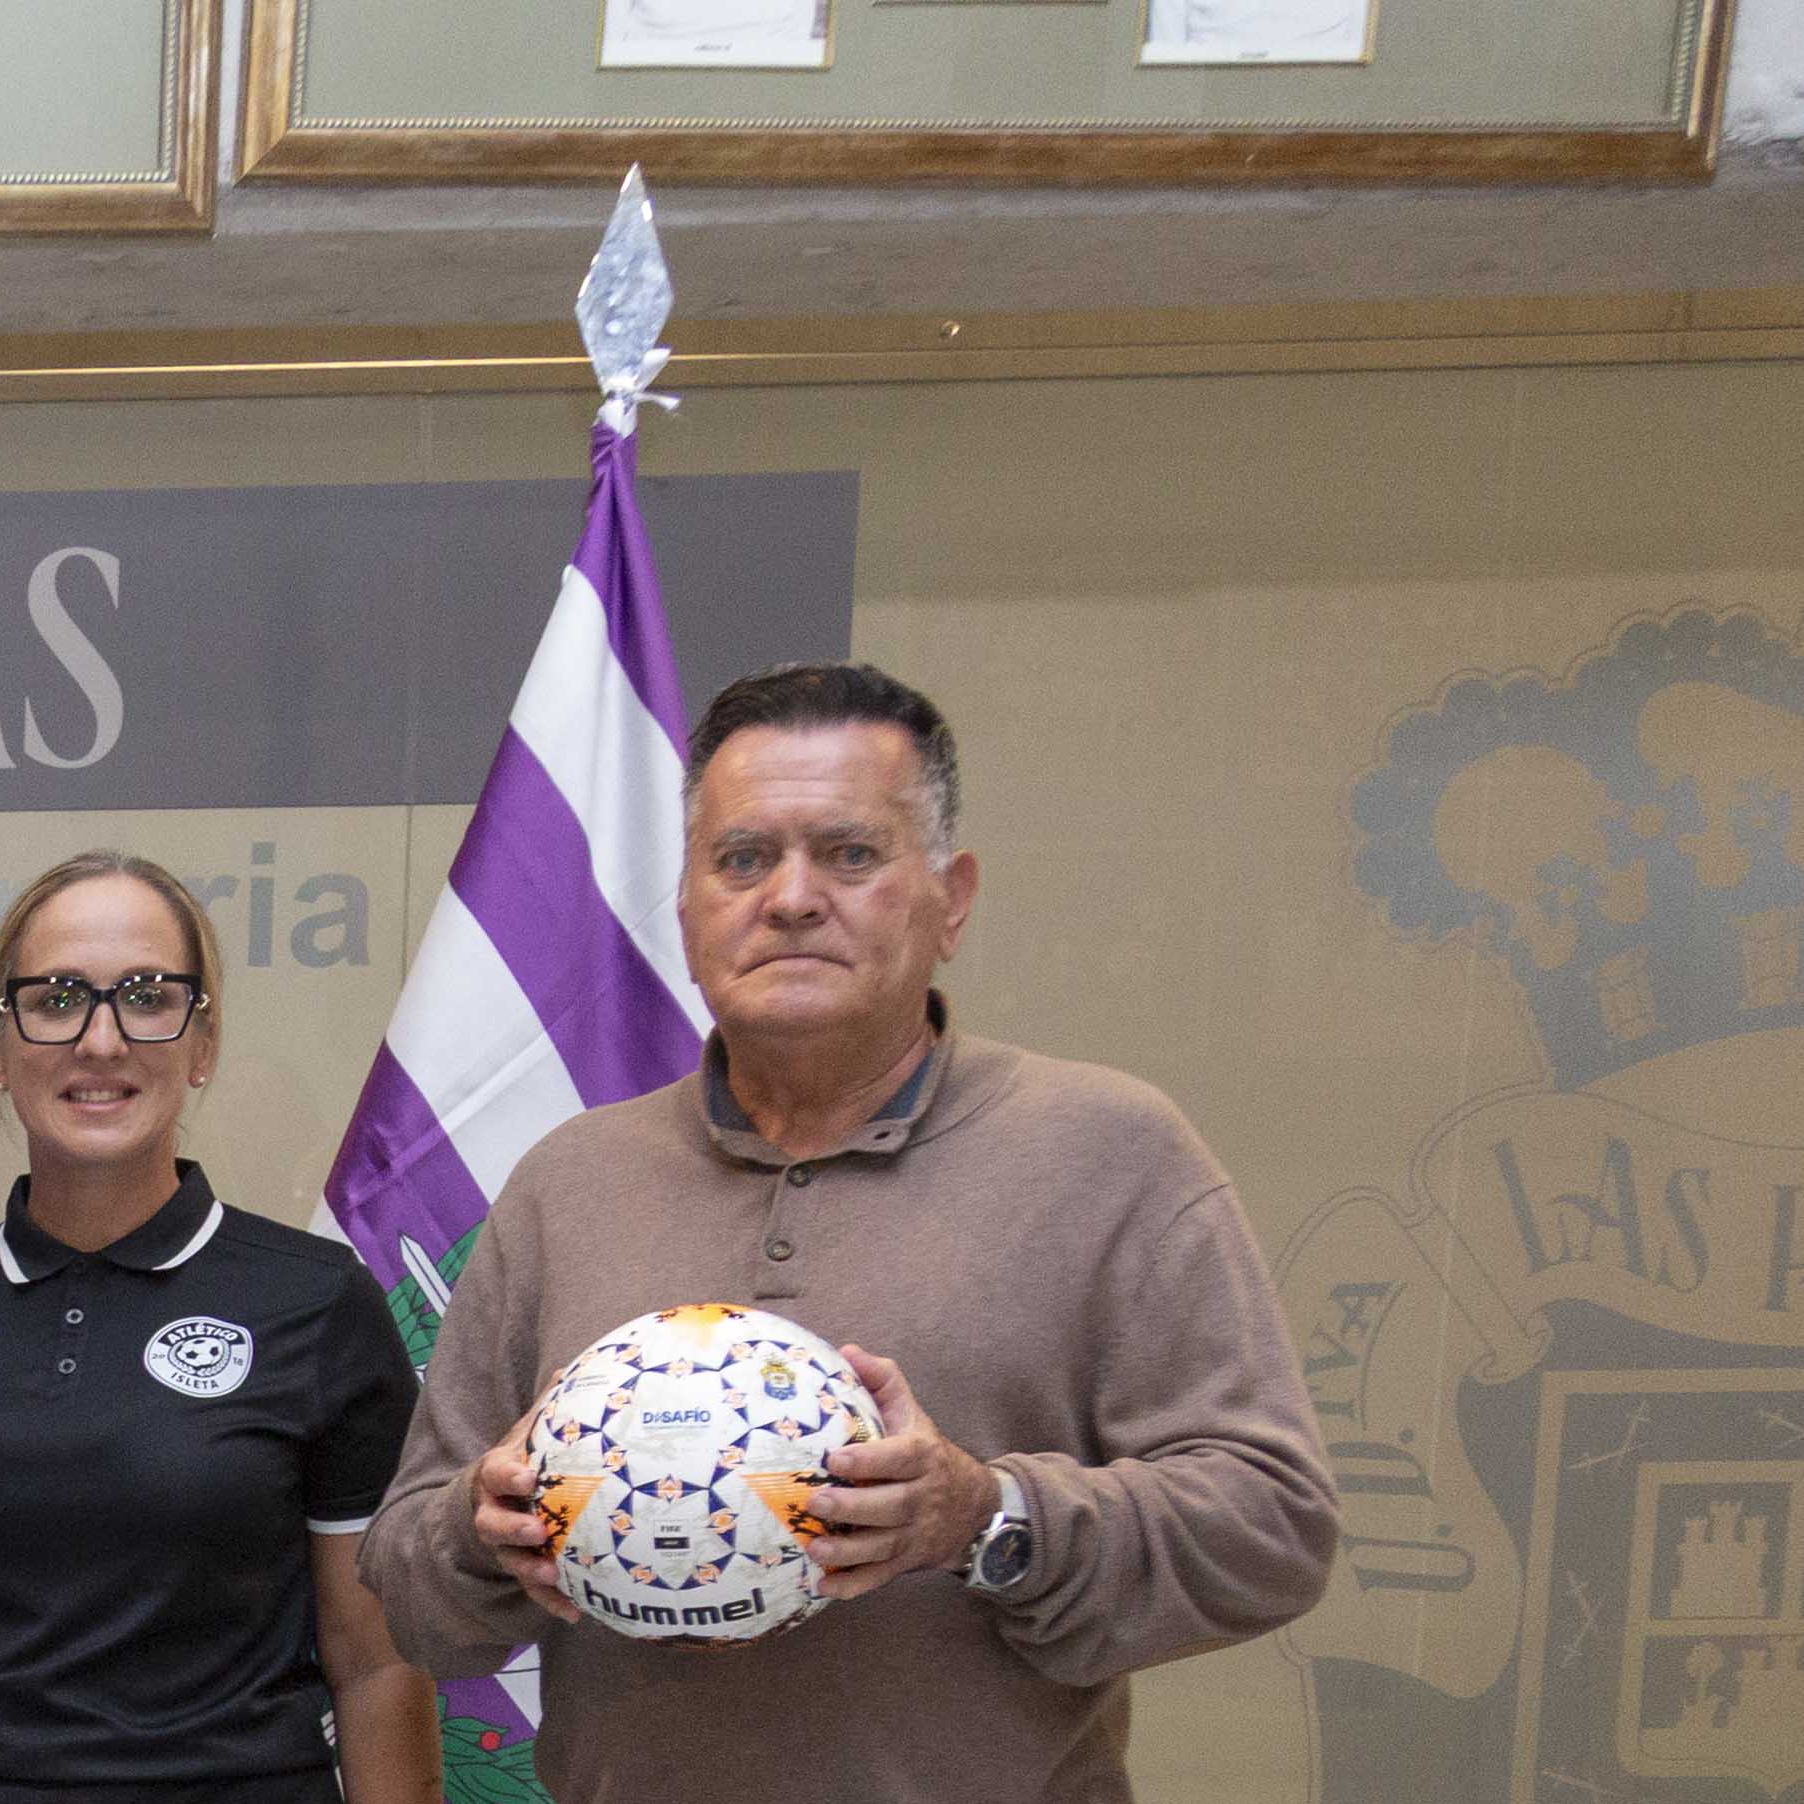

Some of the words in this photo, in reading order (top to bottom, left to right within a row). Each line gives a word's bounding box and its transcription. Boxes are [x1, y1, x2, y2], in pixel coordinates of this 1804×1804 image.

[1489, 1132, 1714, 1295] LAS
[167, 1323, 239, 1343] ATLÉTICO
[170, 1372, 219, 1389] ISLETA
[583, 1579, 766, 1626] hummel
